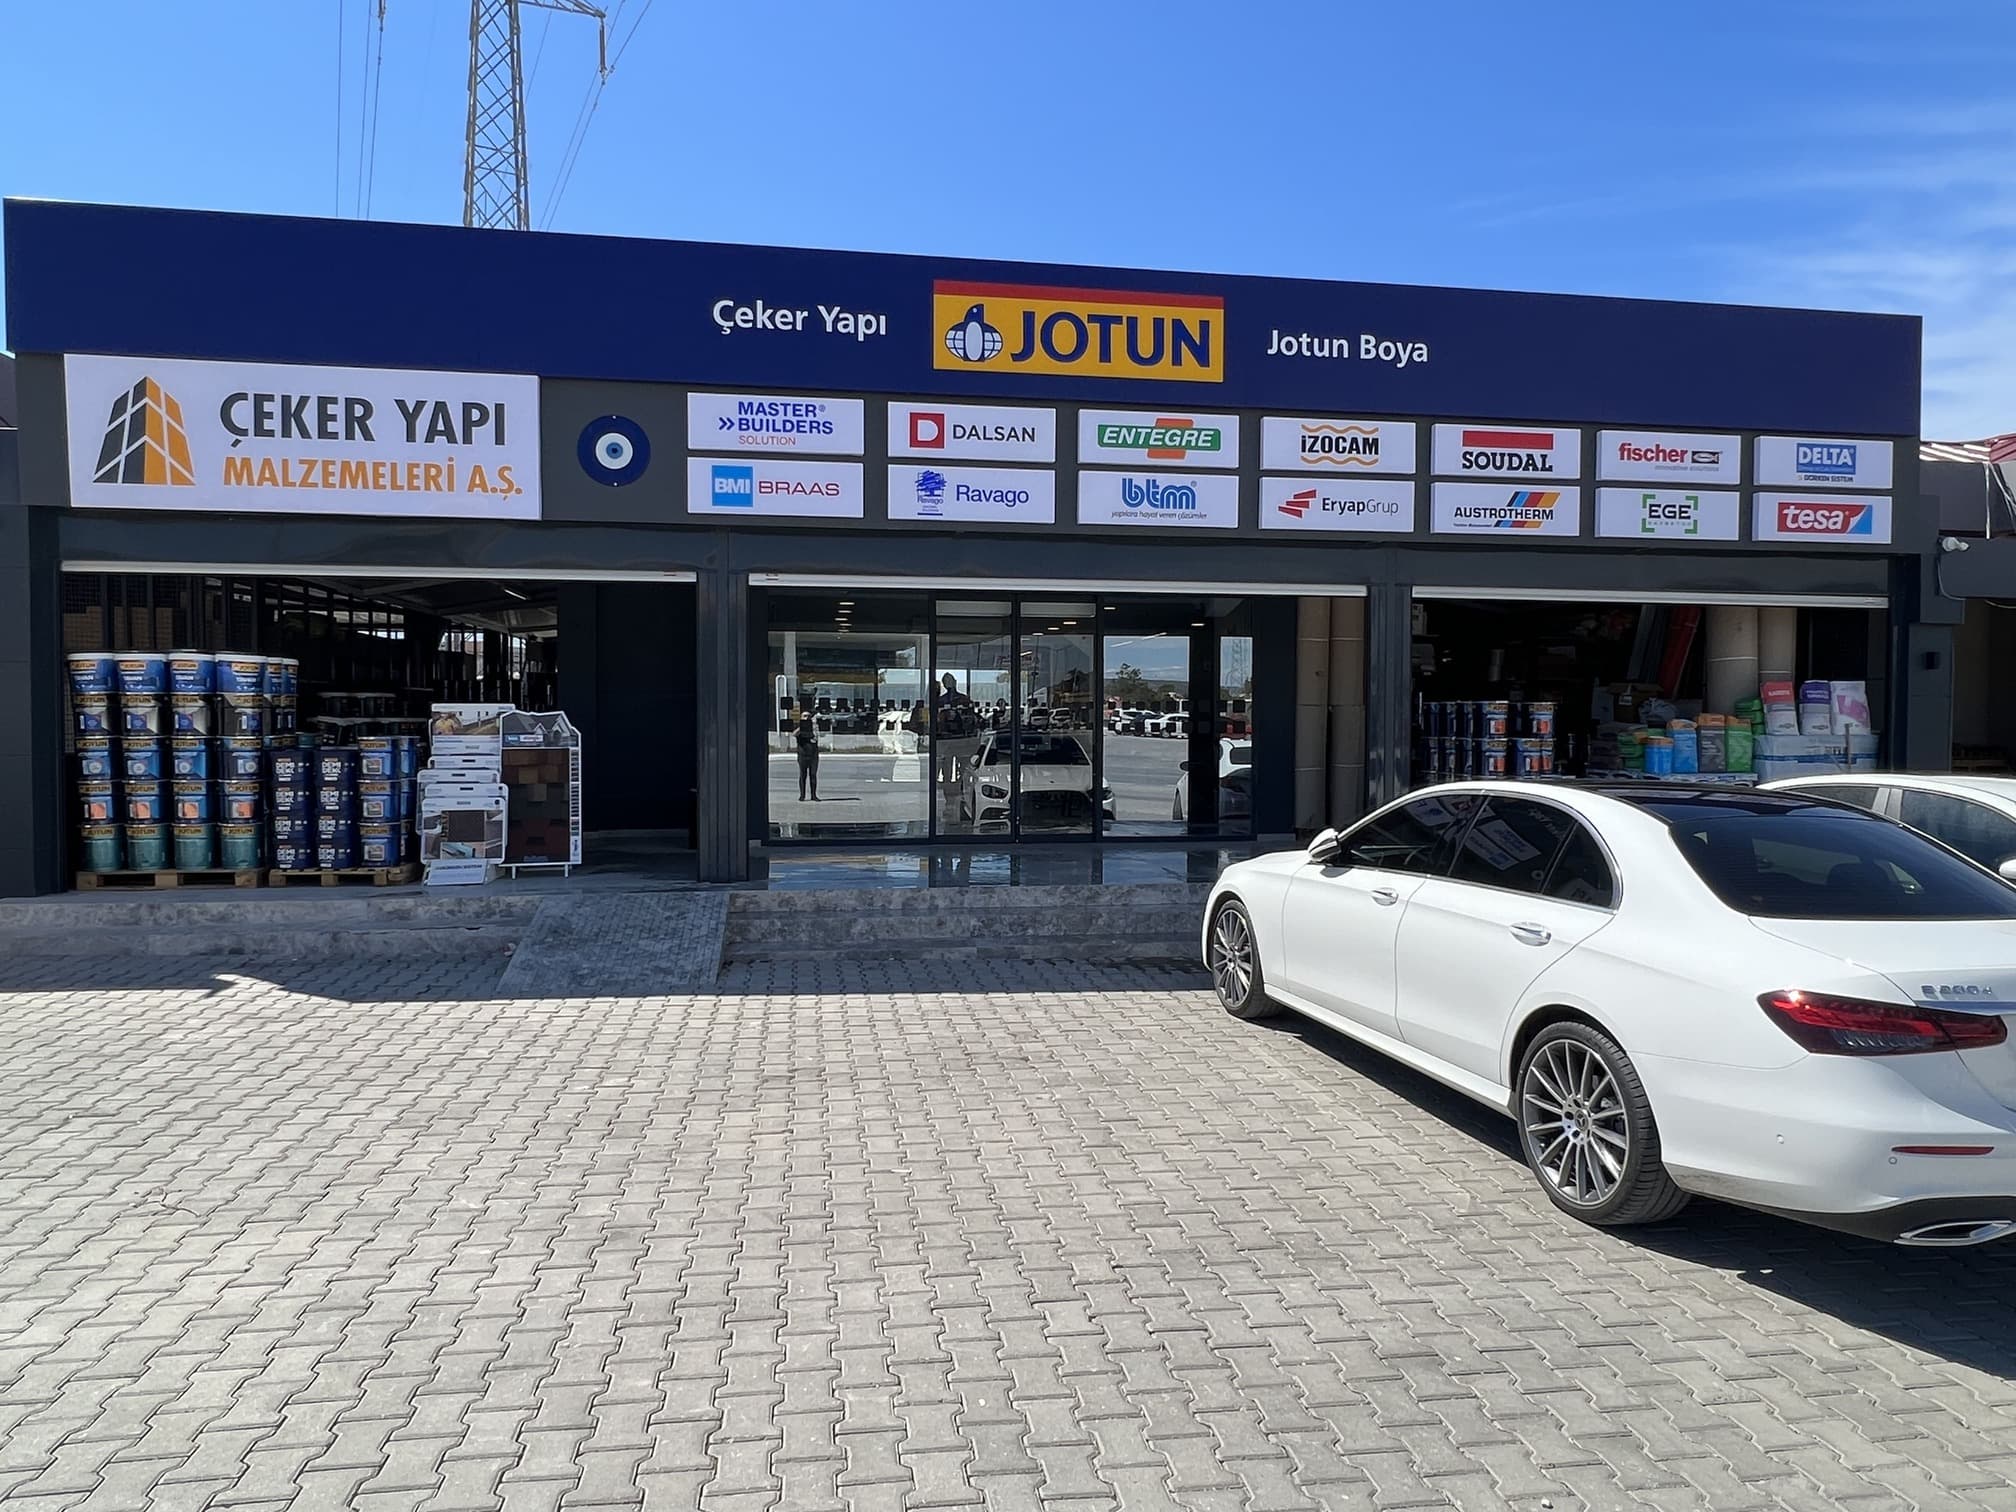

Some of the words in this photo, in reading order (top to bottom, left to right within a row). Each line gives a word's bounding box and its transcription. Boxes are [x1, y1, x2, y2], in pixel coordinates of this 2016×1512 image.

[713, 301, 808, 333] Çeker
[818, 306, 886, 339] Yapı
[1011, 310, 1210, 367] JOTUN
[1268, 330, 1348, 358] Jotun
[1361, 335, 1428, 367] Boya
[220, 392, 375, 448] ÇEKER
[394, 399, 505, 446] YAPI
[738, 416, 834, 434] BUILDERS
[738, 434, 796, 446] SOLUTION
[953, 424, 1036, 442] DALSAN
[1103, 426, 1214, 447] ENTEGRE
[1462, 451, 1553, 472] SOUDAL
[1618, 442, 1688, 463] fischer
[1799, 446, 1853, 466] DELTA
[224, 456, 456, 493] MALZEMELERİ
[467, 464, 523, 500] A.Ş.
[714, 478, 750, 494] BMI
[759, 480, 840, 496] BRAAS
[956, 484, 1029, 507] Ravago
[1322, 497, 1399, 515] EryapGrup
[1454, 506, 1554, 520] AUSTROTHERM
[1649, 504, 1691, 519] EGE
[1783, 505, 1844, 530] tesa
